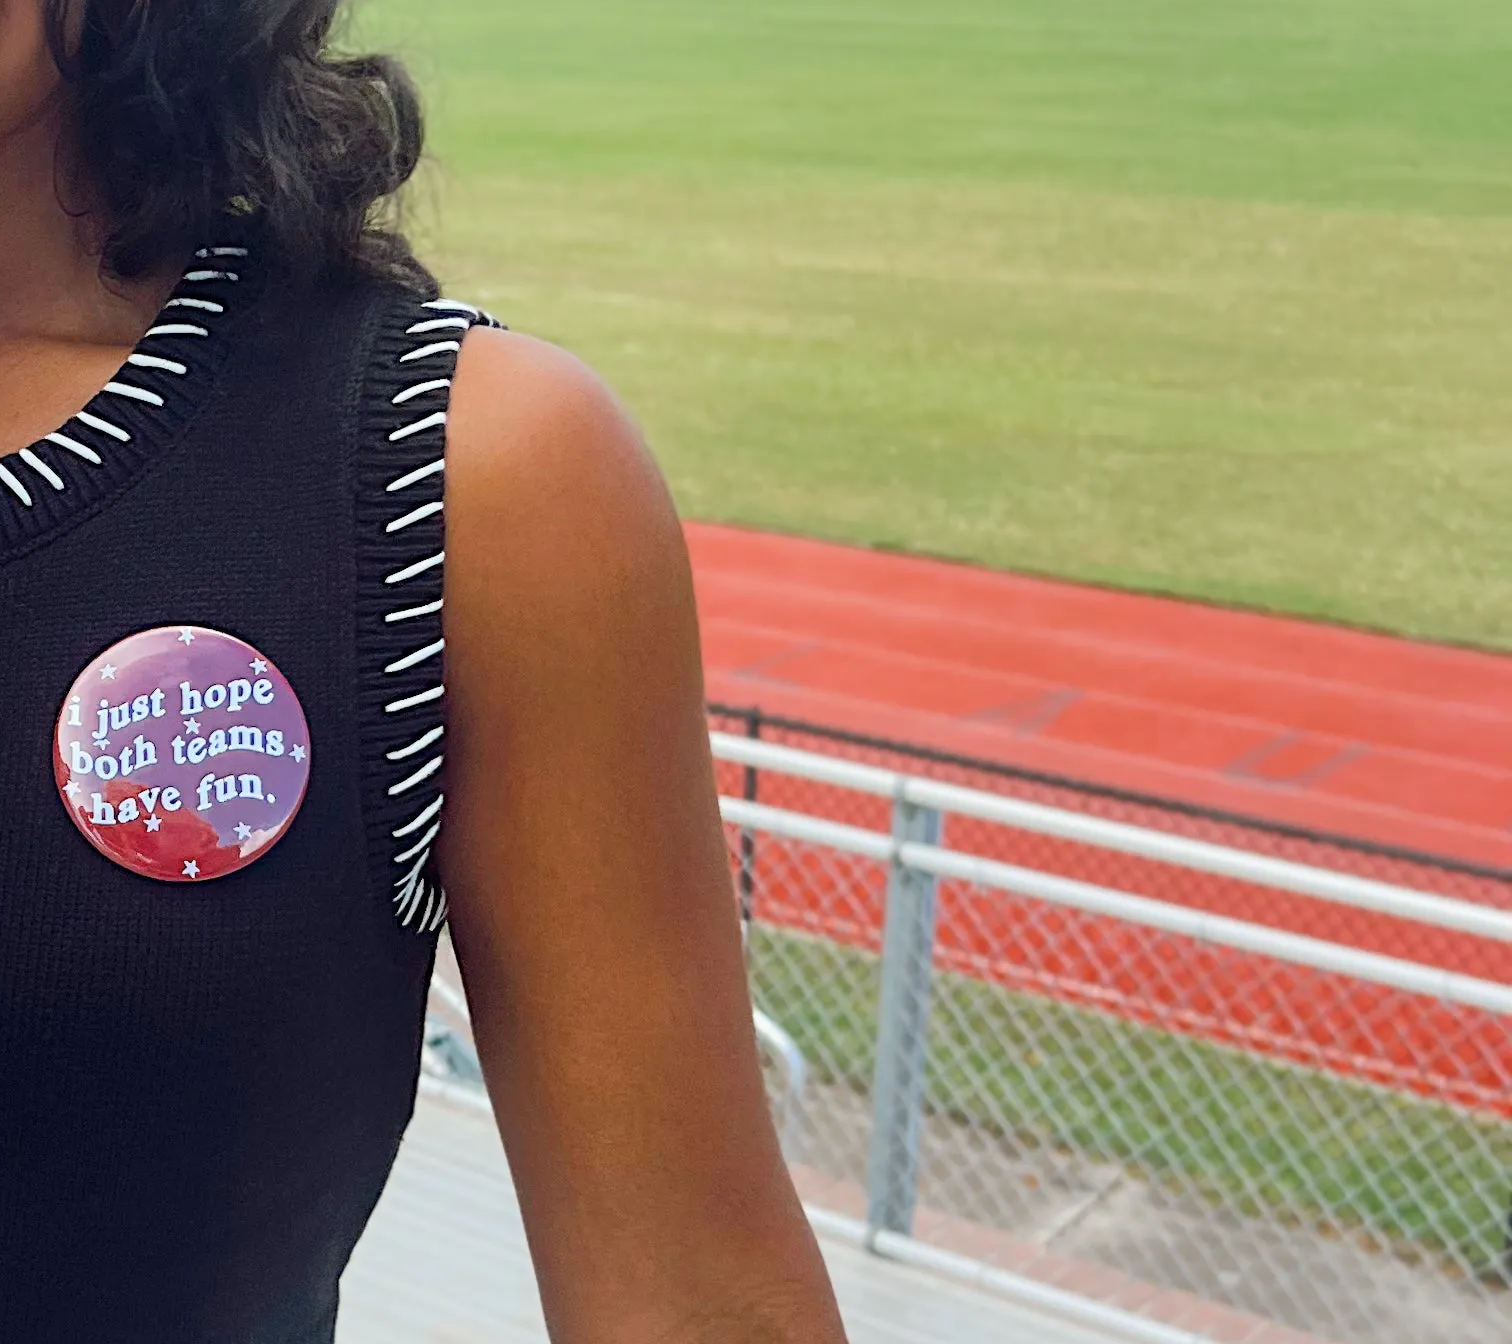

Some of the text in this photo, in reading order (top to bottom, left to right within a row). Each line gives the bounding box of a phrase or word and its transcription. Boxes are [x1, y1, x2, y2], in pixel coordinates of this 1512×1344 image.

[67, 678, 274, 739] i just hope
[69, 725, 285, 781] both teams
[88, 773, 276, 825] have fun.
